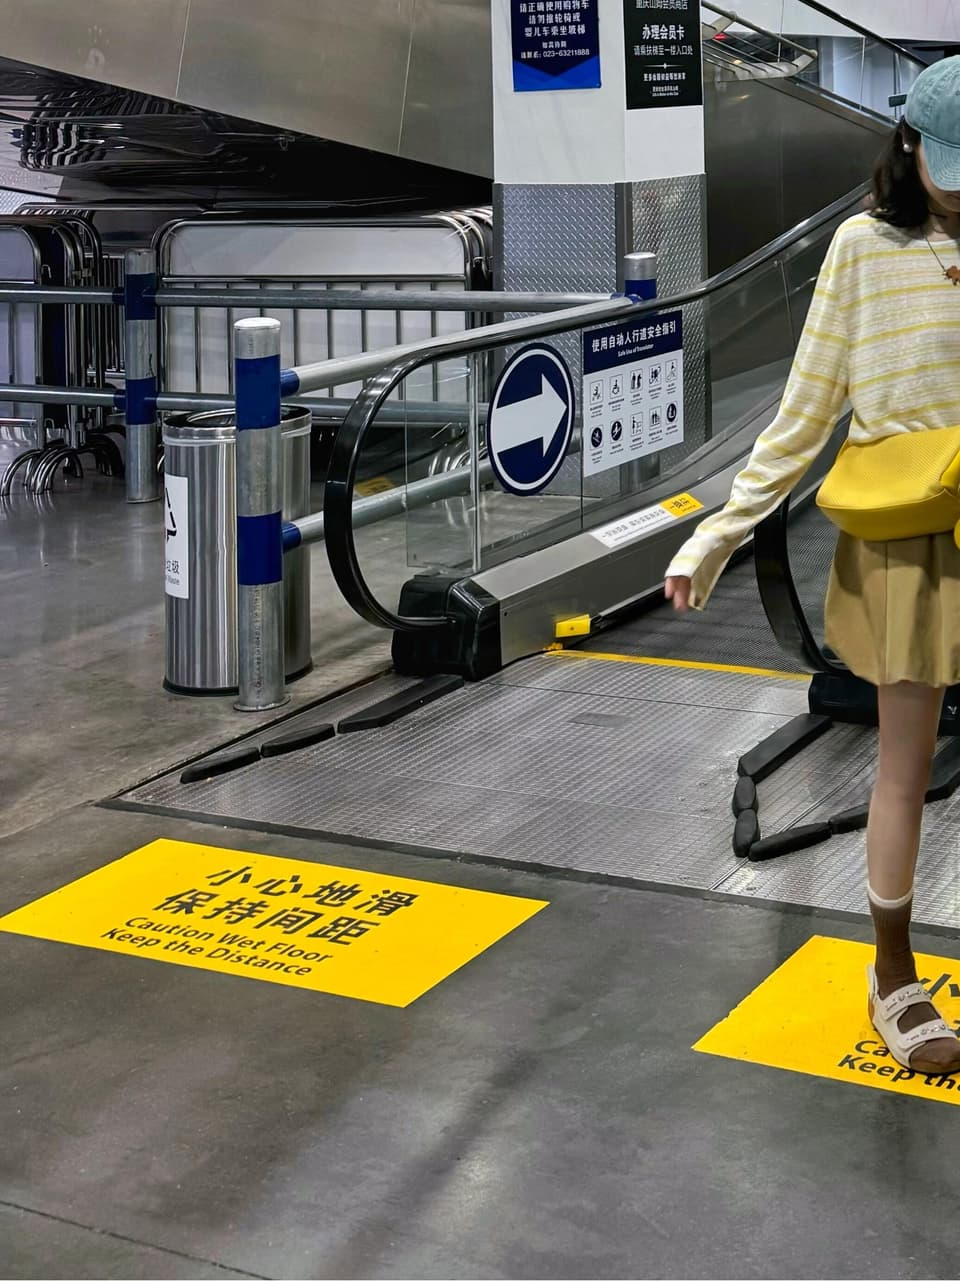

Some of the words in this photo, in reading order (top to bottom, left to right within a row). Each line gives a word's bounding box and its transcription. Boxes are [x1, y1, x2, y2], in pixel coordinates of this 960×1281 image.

[520, 0, 590, 13] 请正确使用购物车
[642, 23, 685, 40] 办理会员卡
[591, 320, 677, 353] 使用自动人行道安全指引
[206, 866, 419, 917] 小心地滑
[152, 888, 380, 946] 保持间距
[100, 927, 161, 949] Keep
[163, 939, 204, 956] the
[205, 947, 312, 976] Distance
[125, 917, 215, 942] Caution
[217, 932, 266, 951] Wet
[265, 941, 333, 963] Floor
[838, 1054, 916, 1082] Keep
